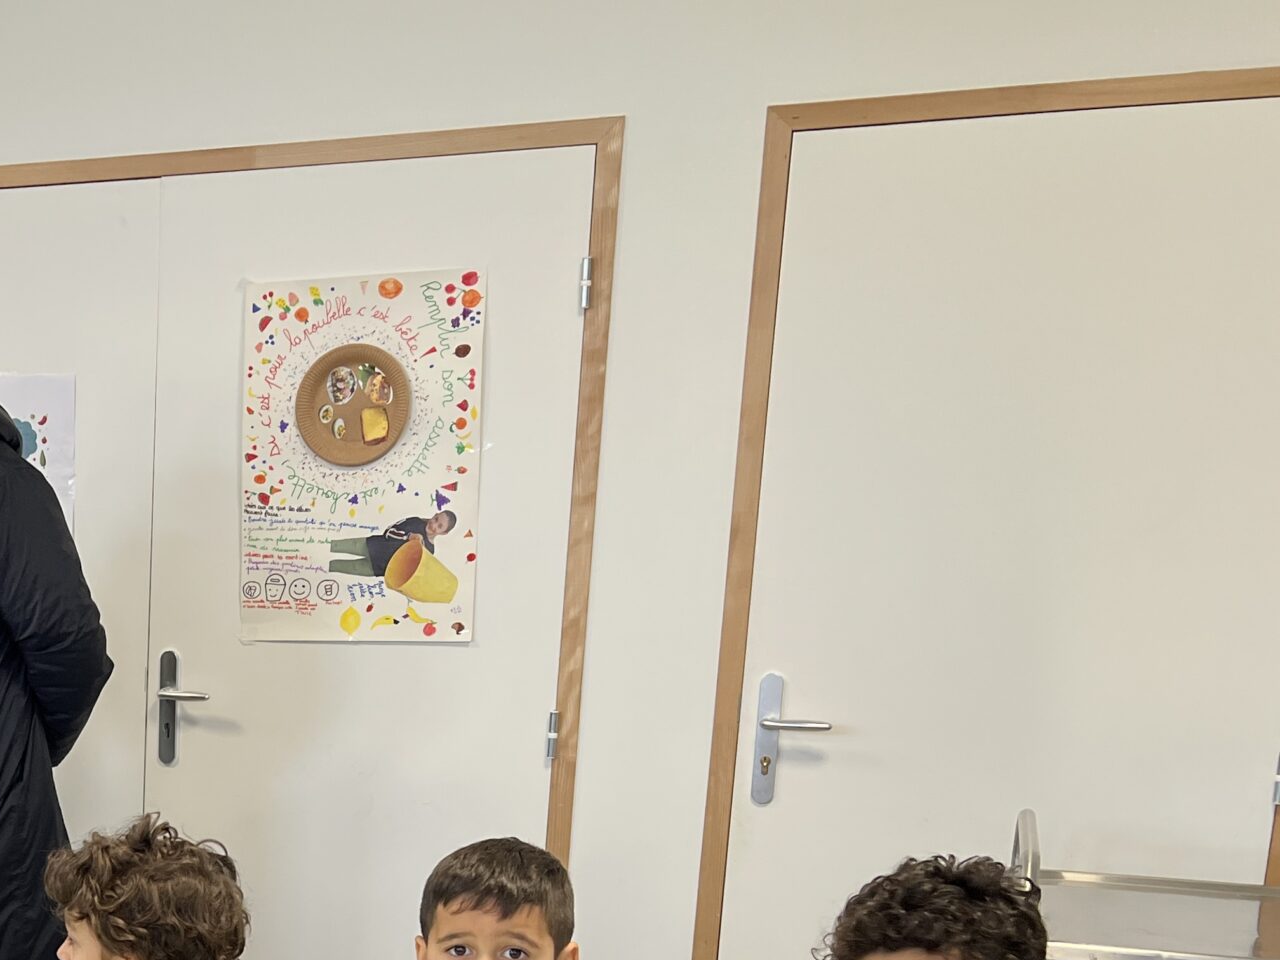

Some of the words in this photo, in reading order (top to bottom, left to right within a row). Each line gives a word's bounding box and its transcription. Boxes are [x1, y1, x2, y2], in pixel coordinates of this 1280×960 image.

[418, 280, 470, 359] Remplir
[256, 392, 271, 428] c'est
[264, 354, 287, 390] pour
[303, 295, 353, 351] poubelle
[401, 415, 445, 478] assiette
[286, 465, 351, 514] chouette
